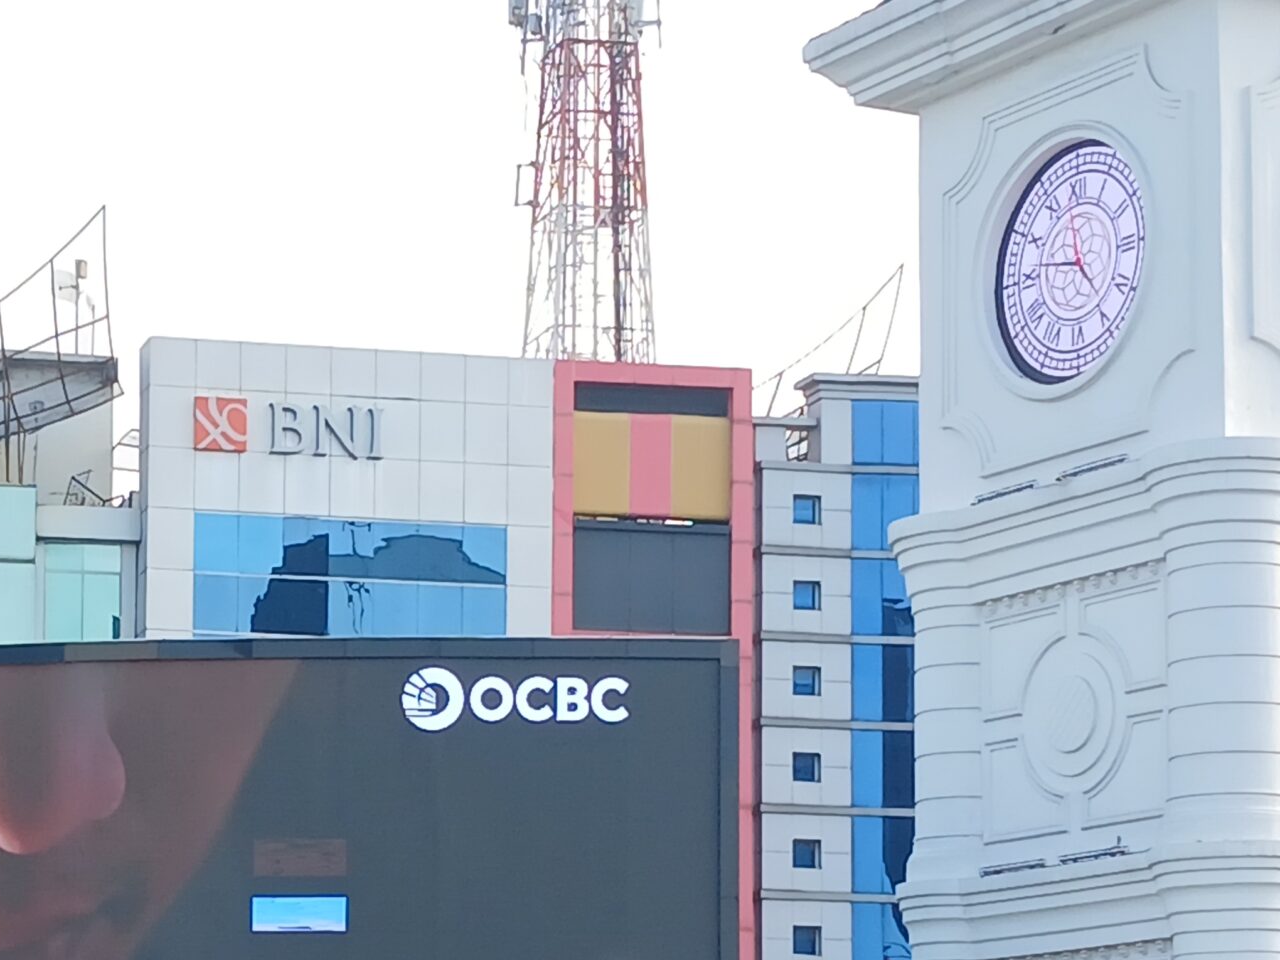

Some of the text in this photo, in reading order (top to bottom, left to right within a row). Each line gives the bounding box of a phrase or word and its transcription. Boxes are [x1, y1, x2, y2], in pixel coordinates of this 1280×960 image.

[1070, 176, 1087, 198] XII
[268, 402, 385, 461] BNI
[469, 675, 630, 723] OCBC
